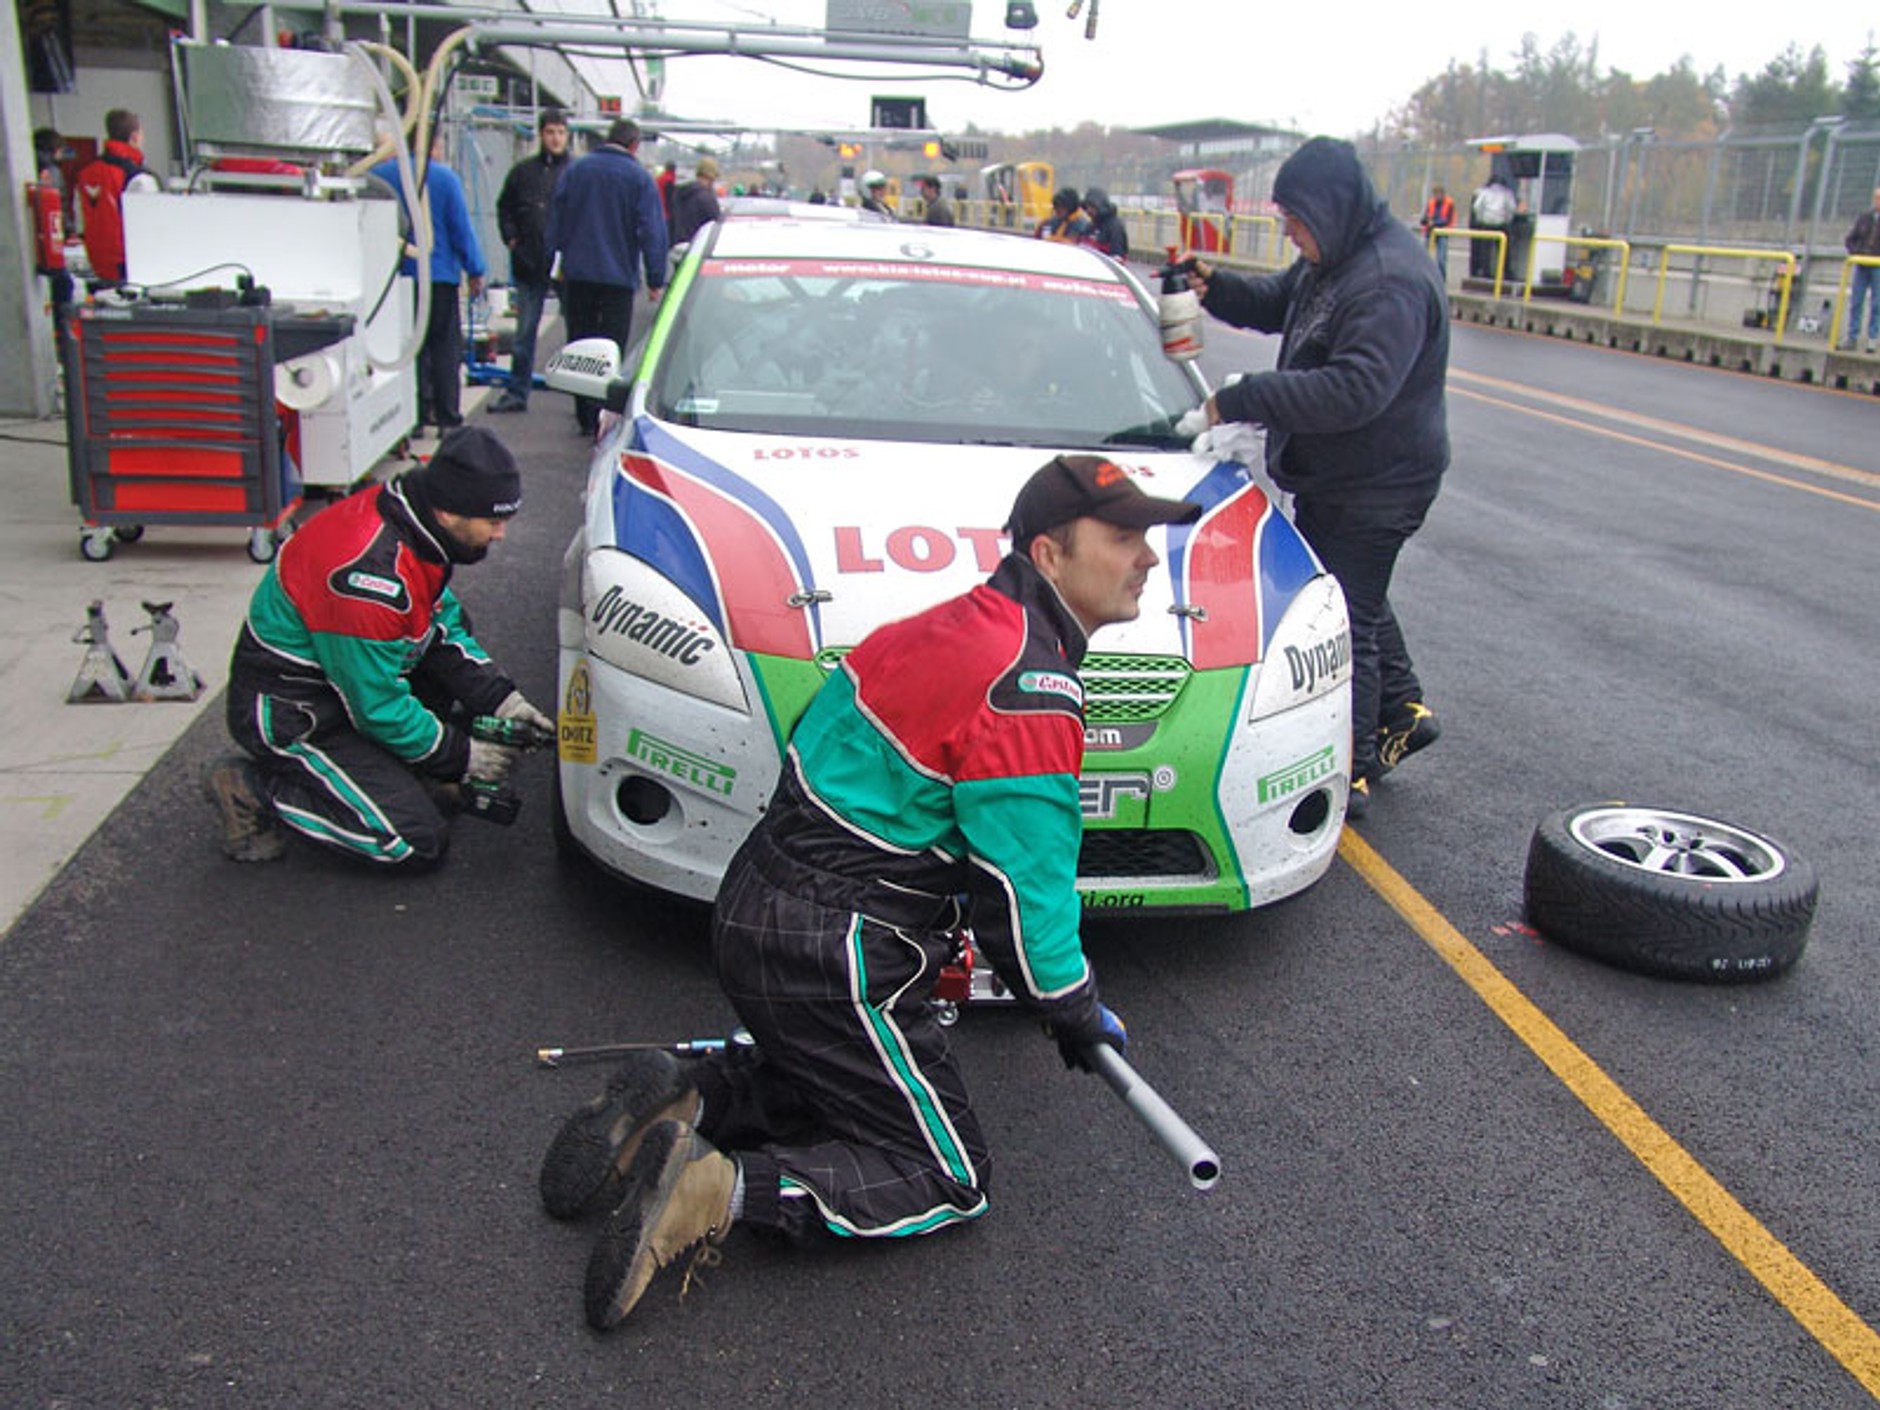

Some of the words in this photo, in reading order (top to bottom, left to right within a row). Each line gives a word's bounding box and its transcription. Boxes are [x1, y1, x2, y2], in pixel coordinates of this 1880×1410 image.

[753, 446, 861, 460] LOTOS
[833, 524, 1012, 574] LOT
[592, 584, 716, 667] Dynamic
[626, 728, 737, 796] PIRELLI
[1083, 728, 1122, 745] om
[1257, 744, 1335, 804] PIRELLI
